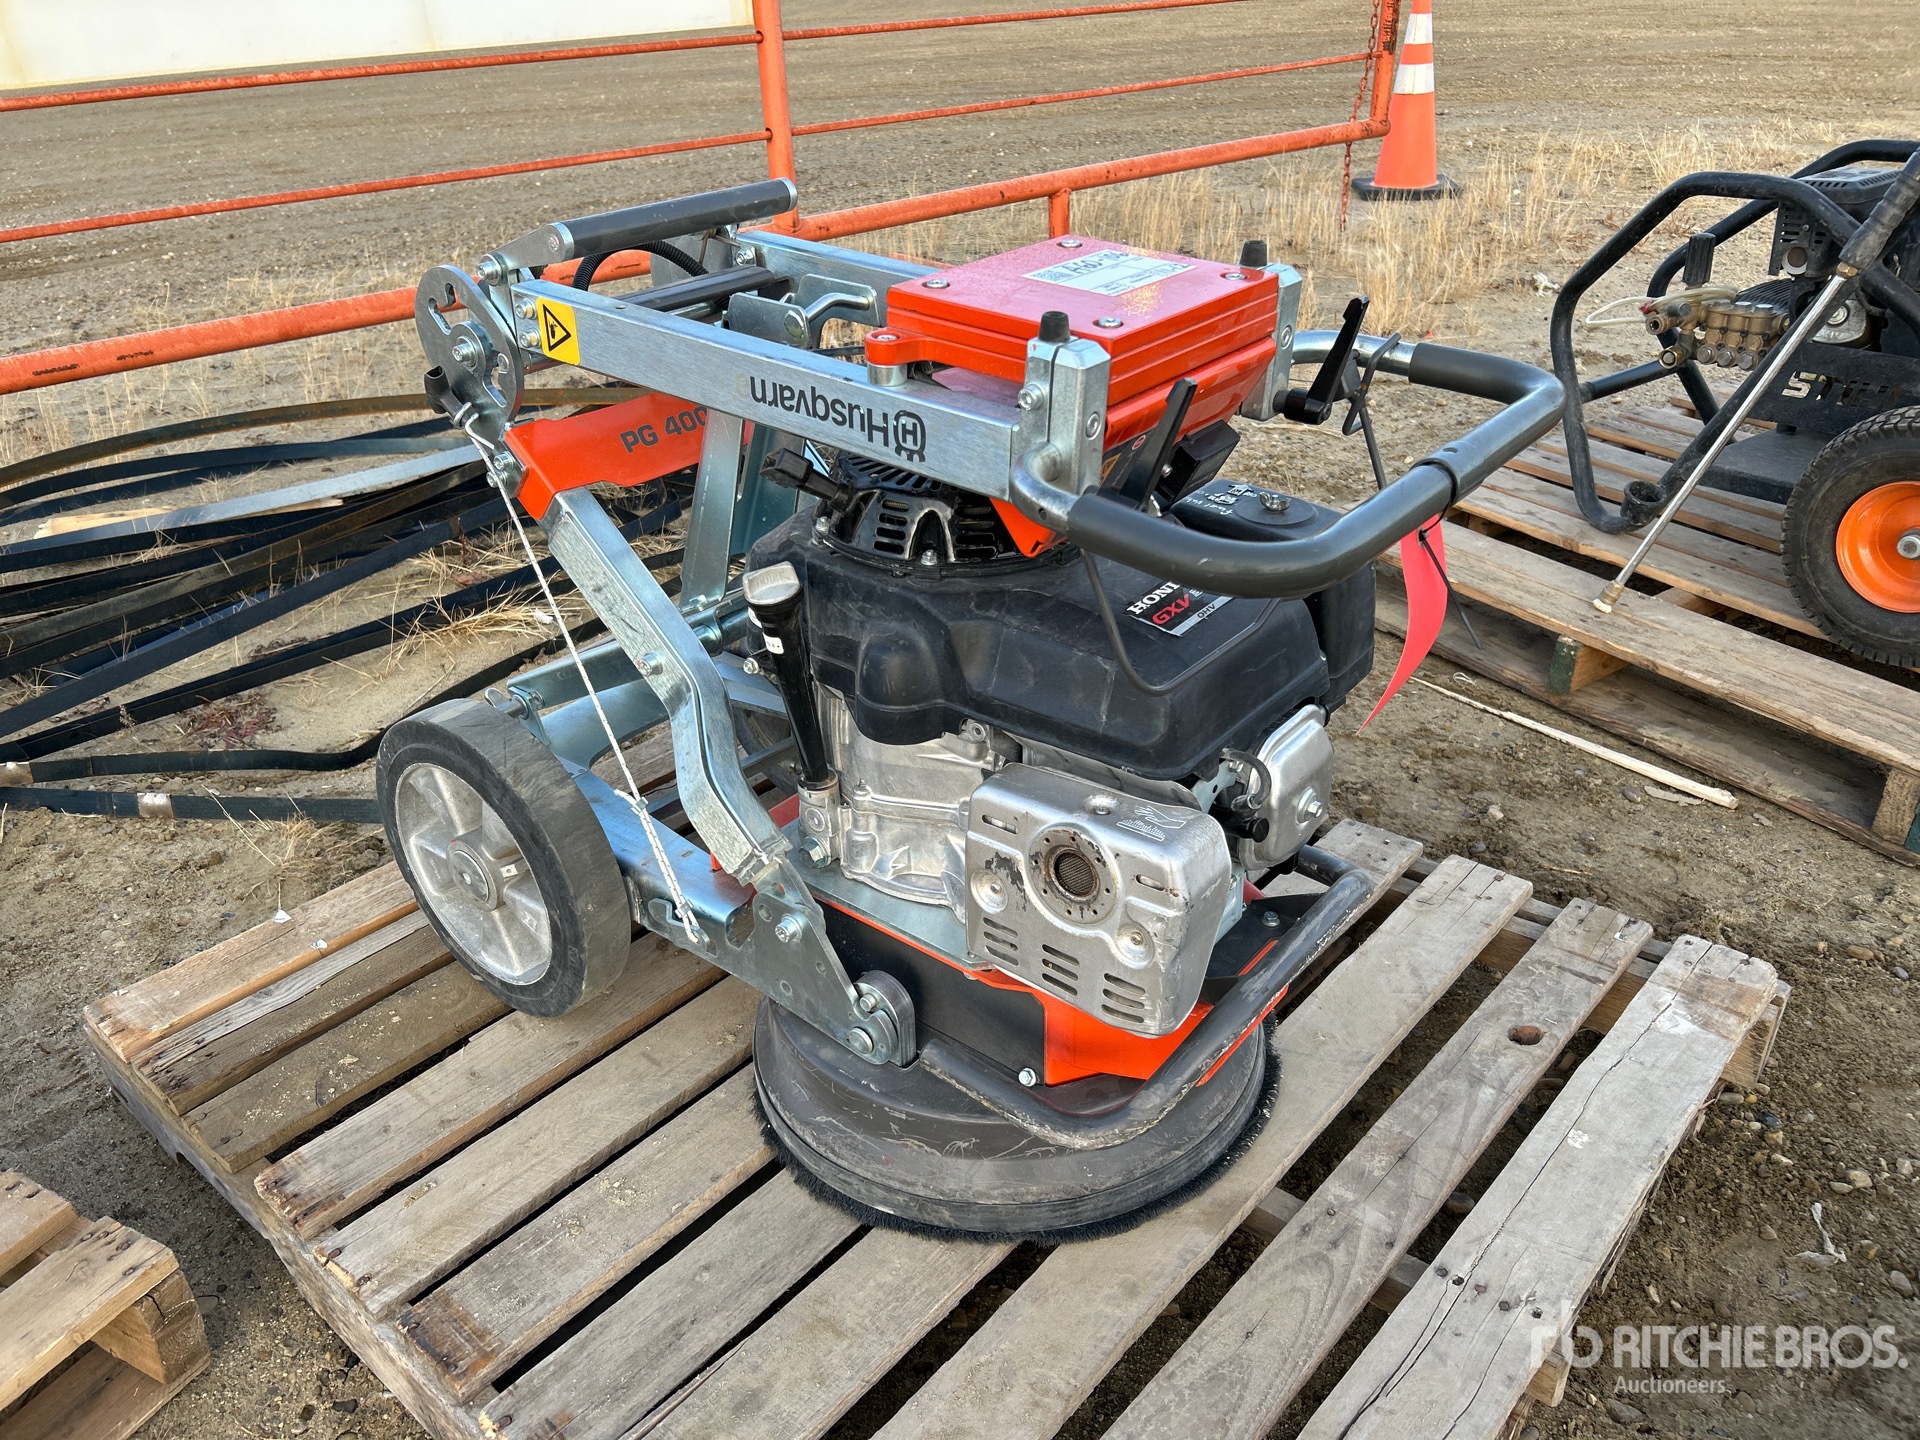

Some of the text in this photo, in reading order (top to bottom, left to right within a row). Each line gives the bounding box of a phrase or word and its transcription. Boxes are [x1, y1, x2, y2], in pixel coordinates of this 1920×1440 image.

[620, 406, 707, 453] PG 400
[1126, 581, 1181, 614] HON
[1152, 593, 1190, 625] GXV
[1197, 603, 1216, 619] OHV
